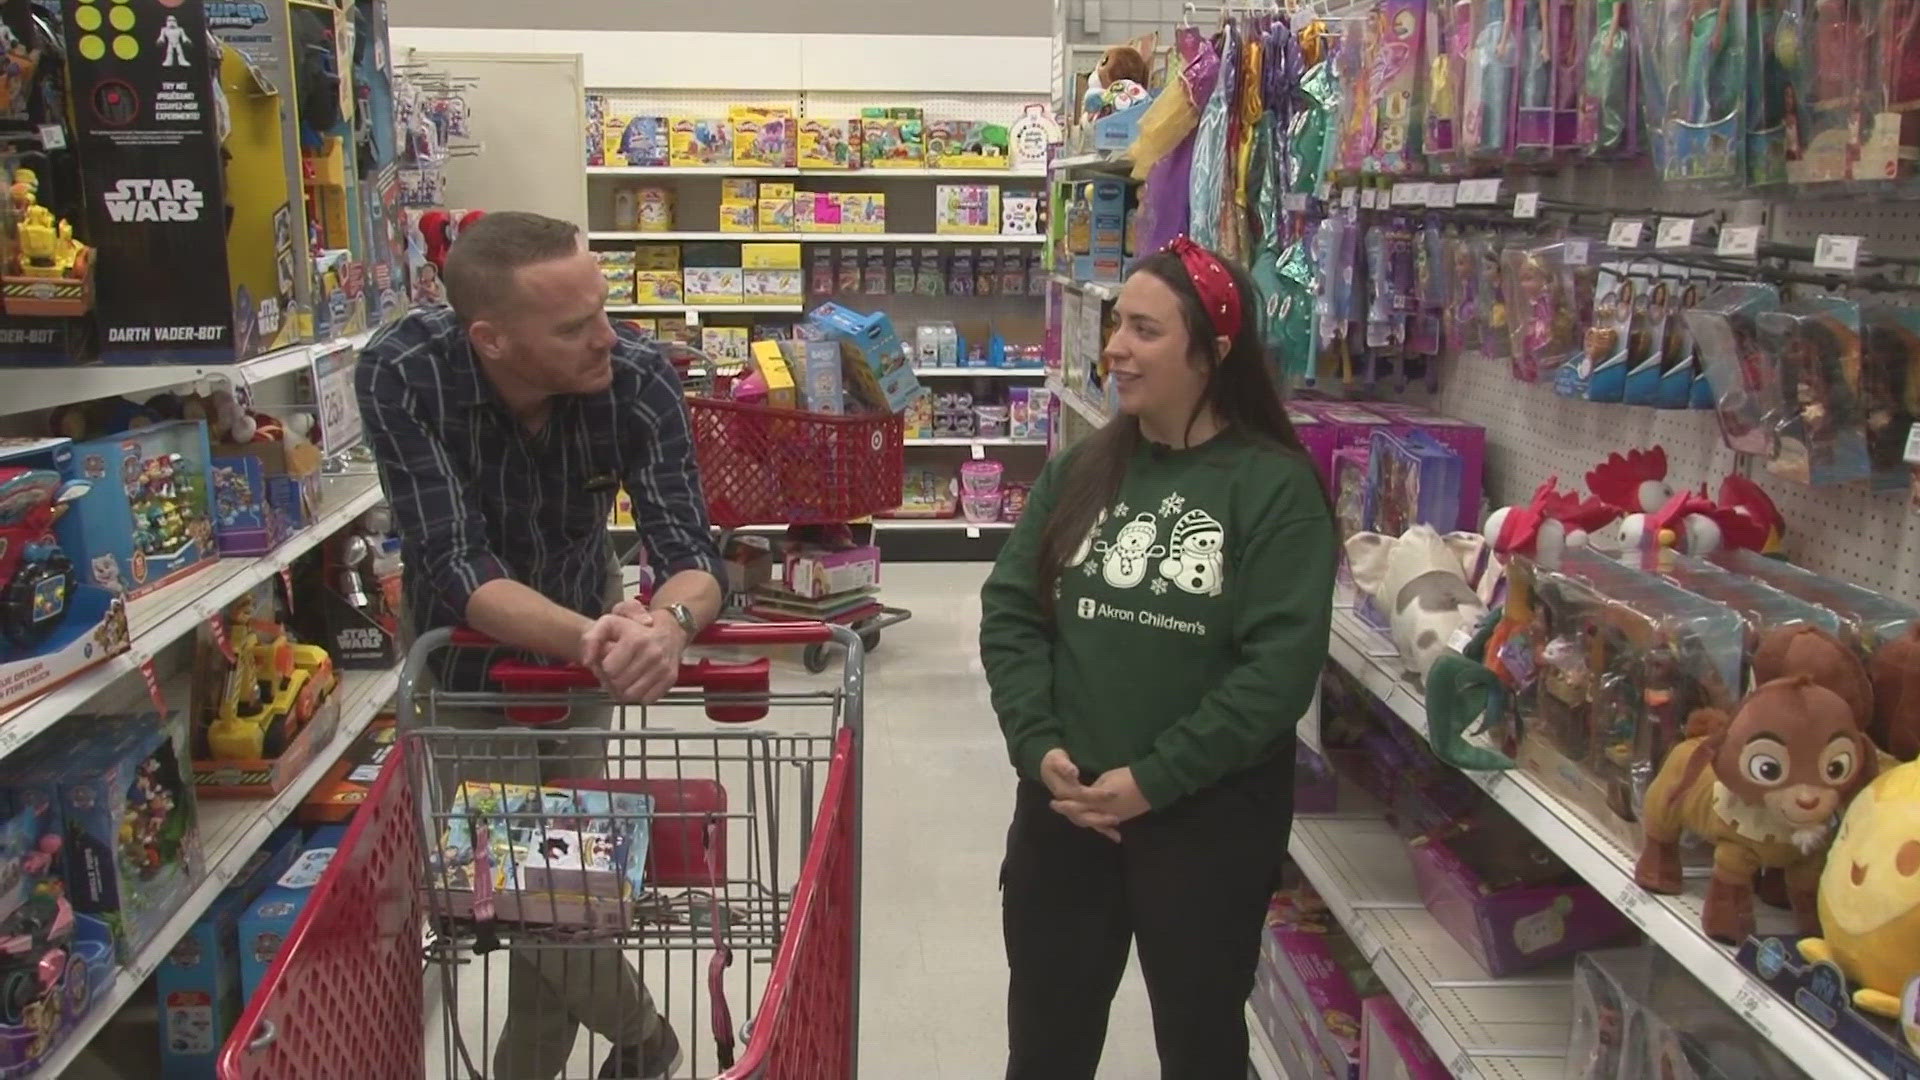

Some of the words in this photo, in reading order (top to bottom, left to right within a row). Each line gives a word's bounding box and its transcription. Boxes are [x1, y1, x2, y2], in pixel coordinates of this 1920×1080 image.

[103, 178, 203, 201] STAR
[104, 200, 204, 223] WARS
[108, 327, 151, 342] DARTH
[154, 325, 224, 342] VADER-BOT
[1098, 603, 1134, 622] Akron
[1138, 611, 1206, 636] Children's
[337, 627, 383, 641] STAR
[338, 637, 382, 650] WARS
